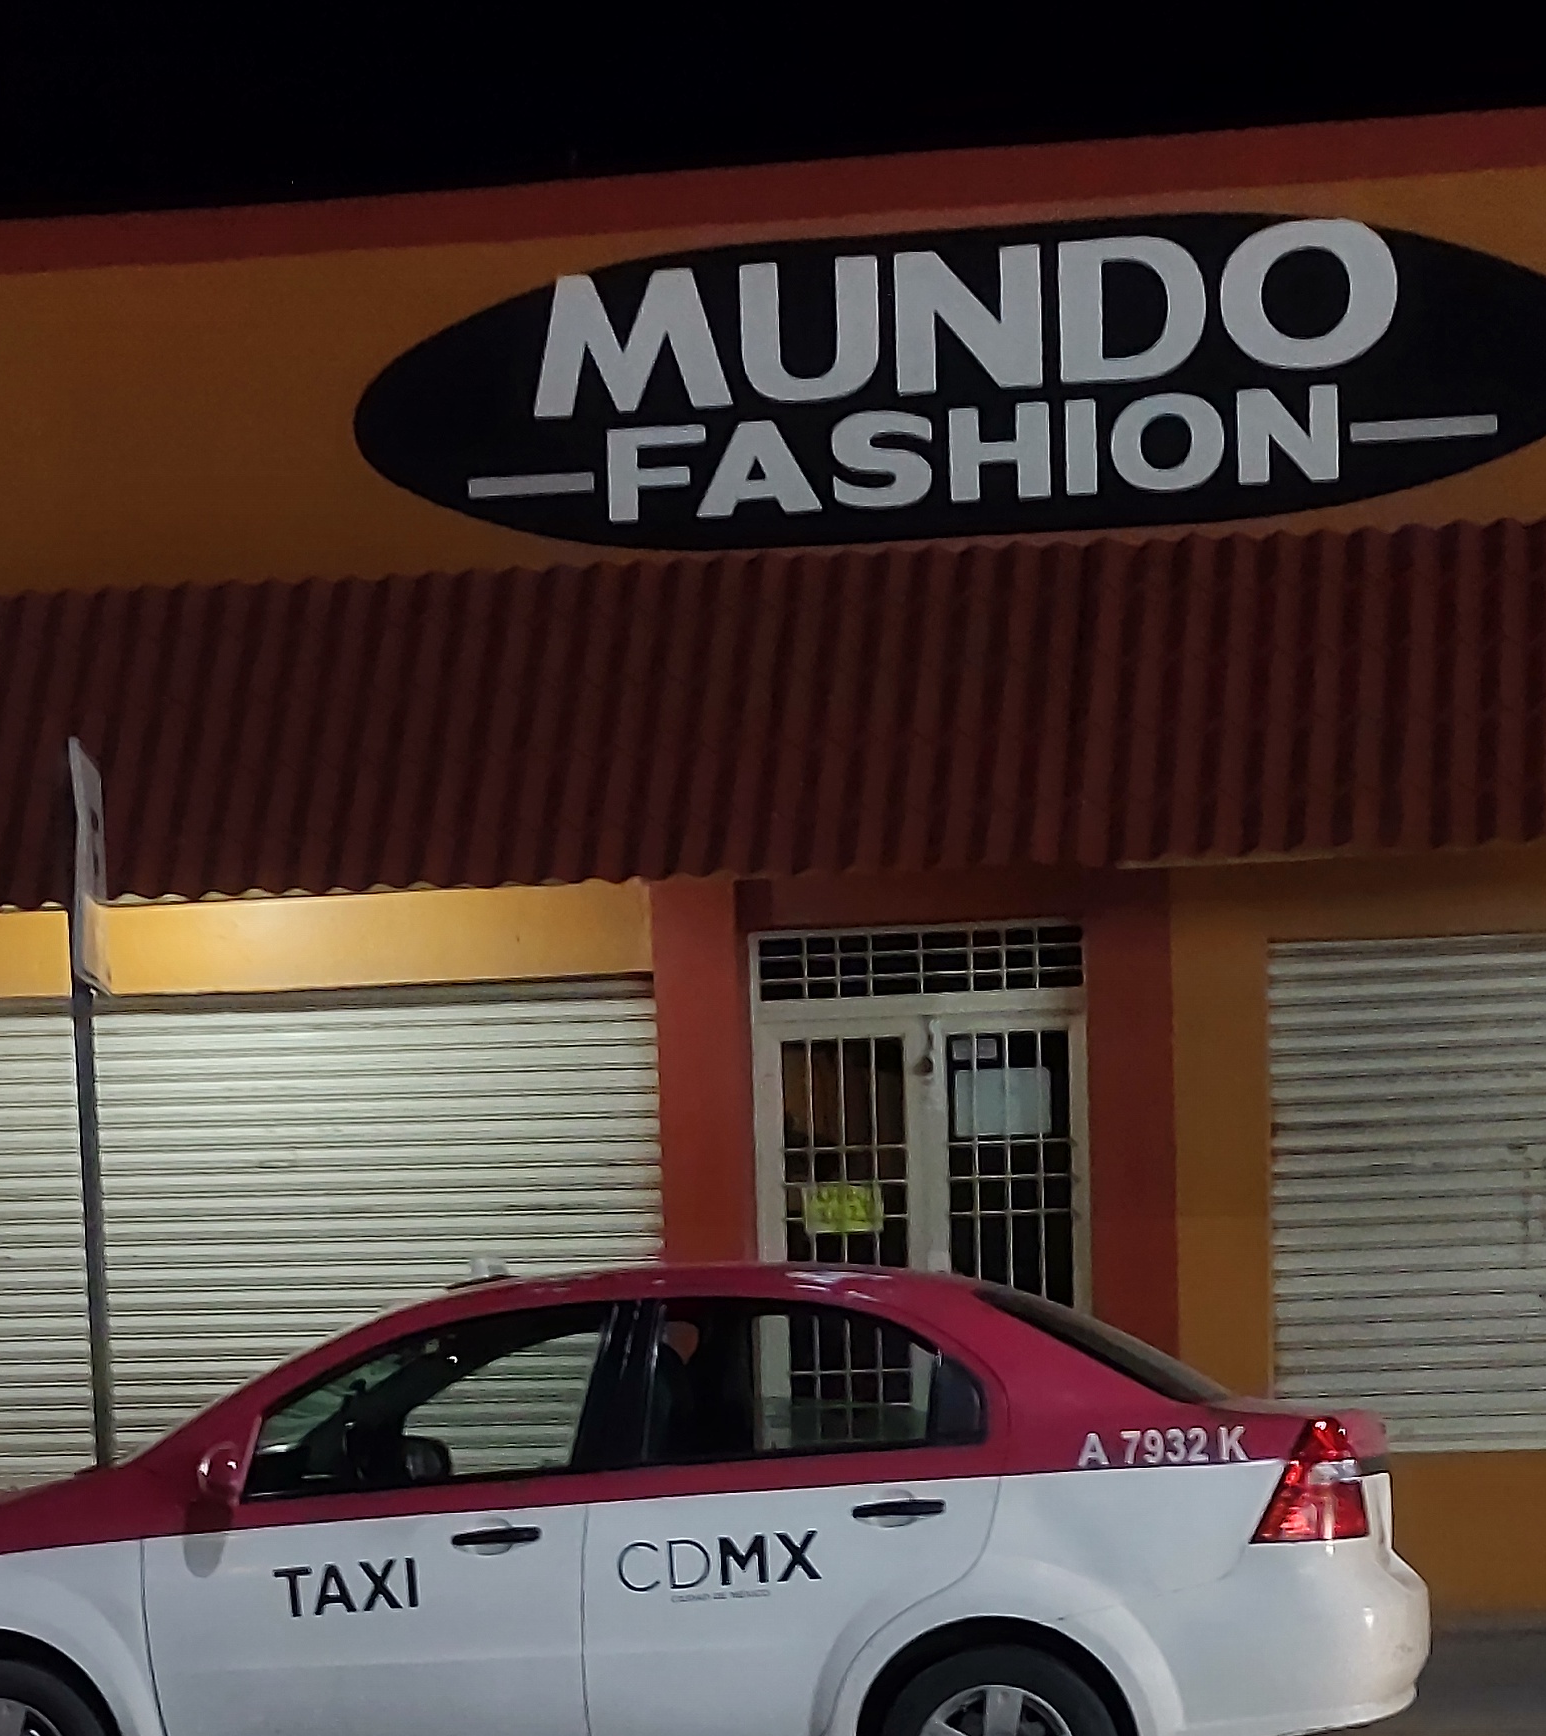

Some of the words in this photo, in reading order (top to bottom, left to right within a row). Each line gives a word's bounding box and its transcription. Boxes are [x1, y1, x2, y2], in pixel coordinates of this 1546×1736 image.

[534, 218, 1399, 418] MUNDO
[605, 383, 1339, 523] FASHION
[1078, 1432, 1111, 1468] A
[1119, 1426, 1210, 1465] 7932
[1217, 1425, 1249, 1462] K
[272, 1556, 420, 1618] TAXI
[617, 1528, 823, 1592] CDMX
